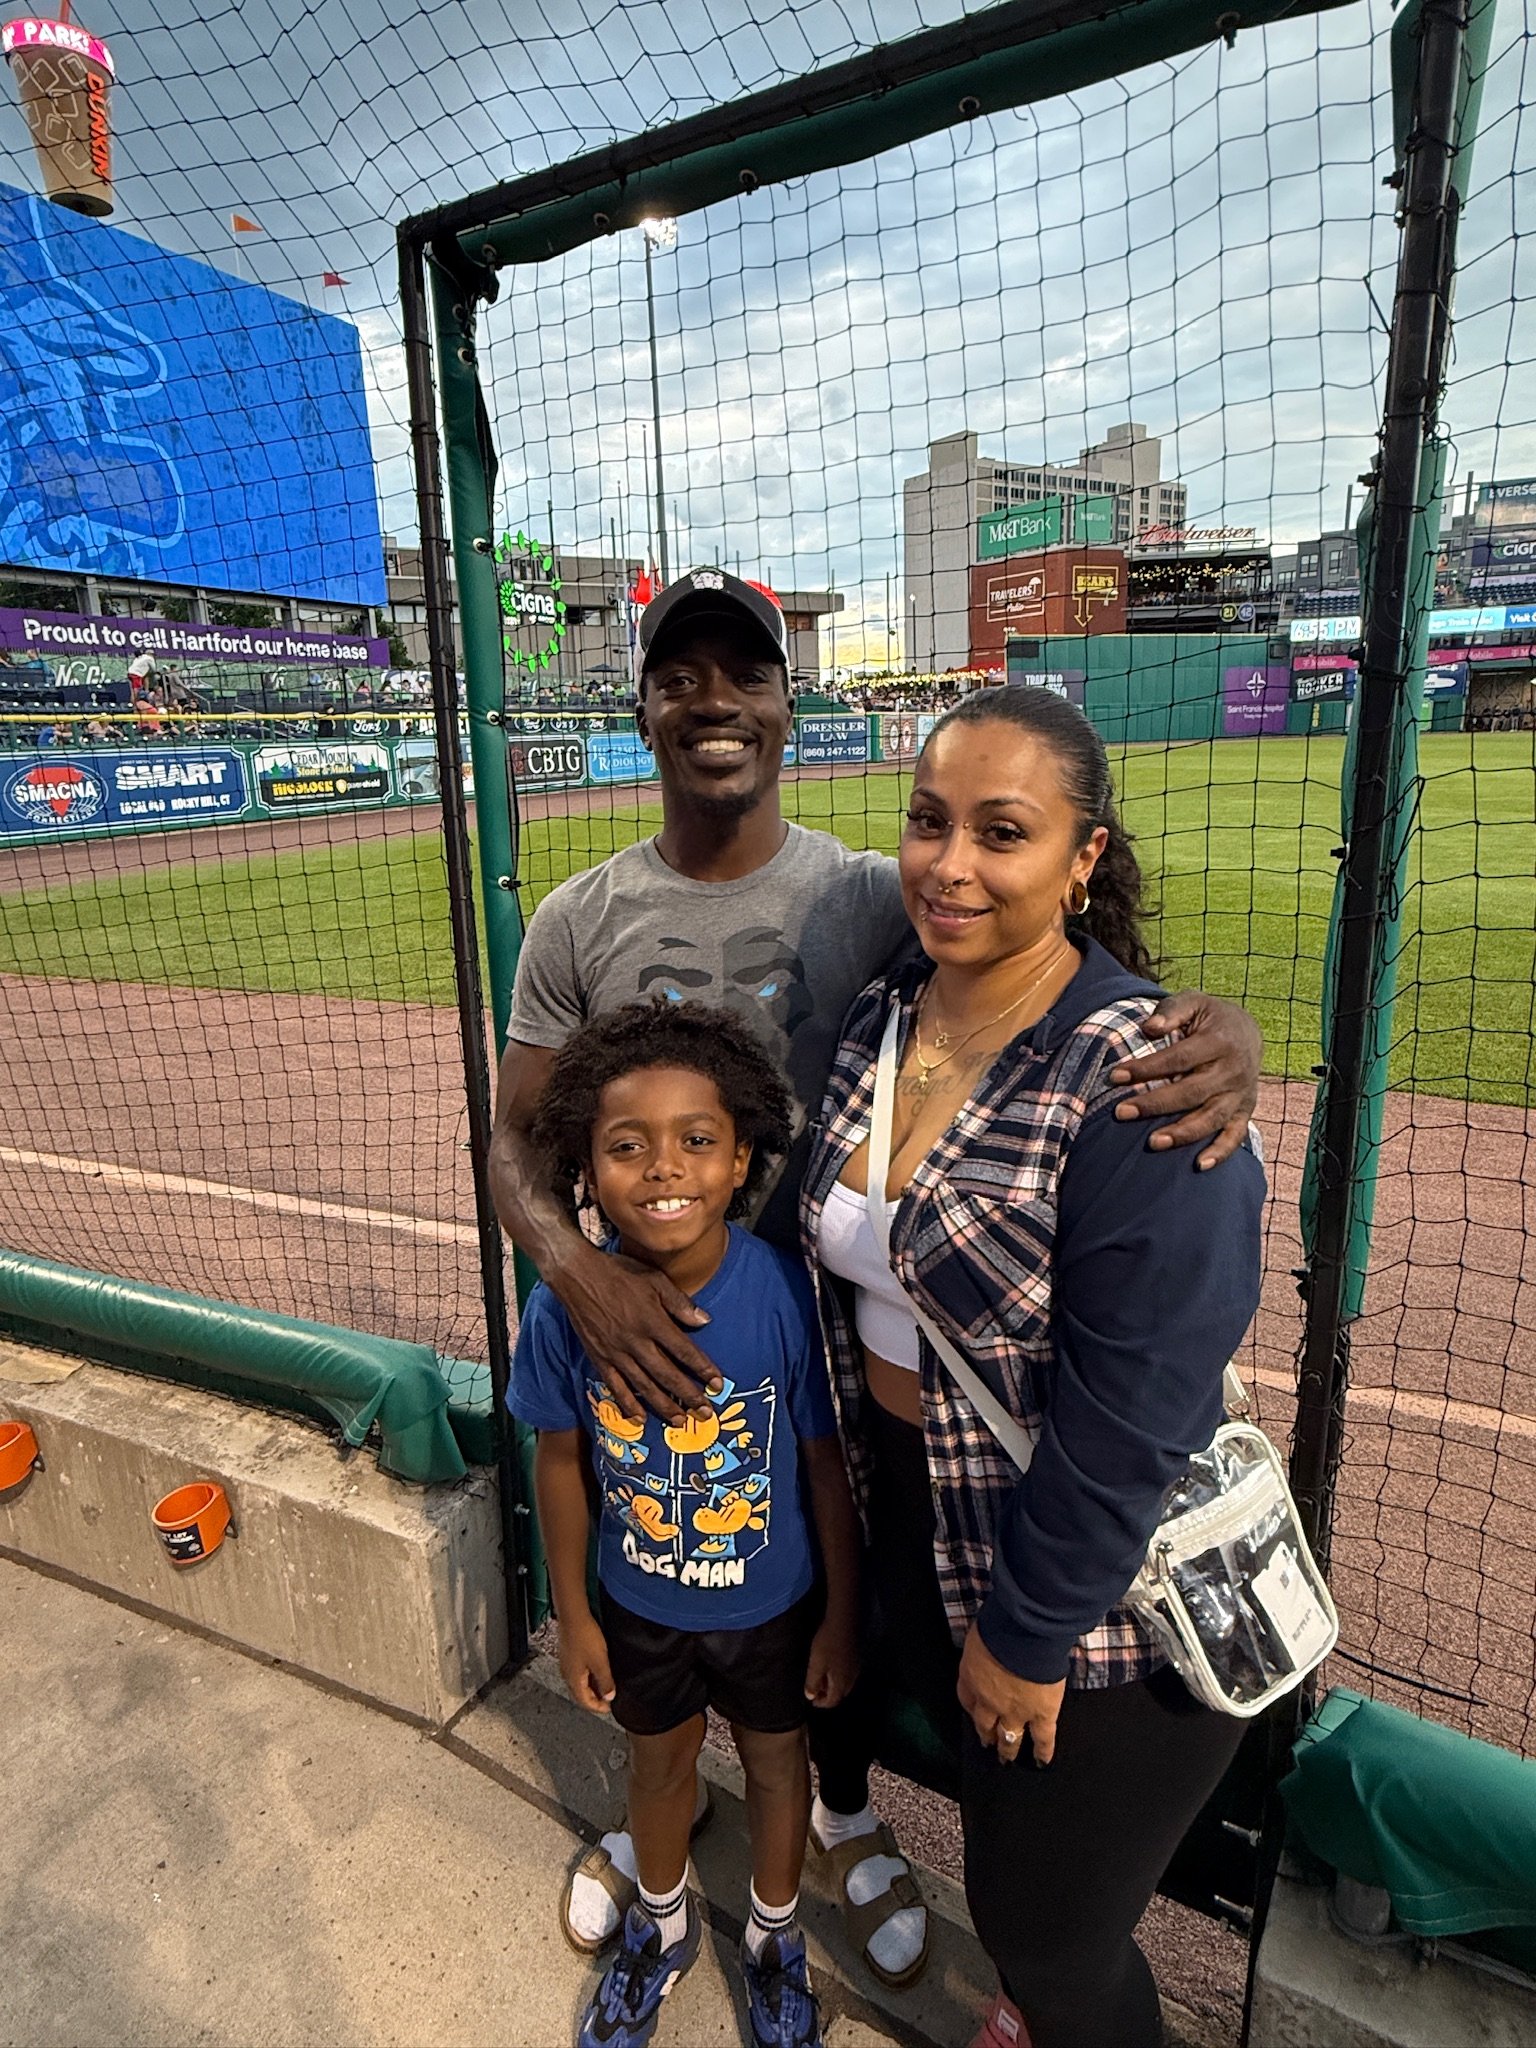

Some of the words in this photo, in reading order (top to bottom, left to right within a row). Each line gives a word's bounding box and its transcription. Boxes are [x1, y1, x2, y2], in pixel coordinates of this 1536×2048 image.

[23, 21, 90, 54] PARK!
[989, 519, 1021, 543] M&T
[1021, 516, 1052, 537] Bank
[1138, 524, 1256, 545] Budweiser
[1076, 576, 1114, 587] BEAR'S
[990, 585, 1033, 602] TRAVELERS
[23, 618, 99, 645] Proud
[101, 625, 126, 646] to
[129, 627, 169, 650] call
[170, 629, 250, 654] Hartford
[254, 638, 284, 656] our
[285, 637, 331, 658] home
[332, 640, 368, 660] base
[1294, 621, 1328, 639] 6:55
[1334, 619, 1359, 637] PM
[803, 721, 866, 734] DRESSLER
[820, 732, 849, 743] LAW
[291, 750, 318, 766] CEDAR
[528, 745, 580, 774] CBTG
[803, 747, 825, 758] (860)
[826, 746, 866, 757] 247-1122
[297, 766, 320, 778] Stone
[598, 756, 652, 771] RADIOLOGY
[115, 761, 227, 790] SMART
[15, 780, 98, 803] SMACNA
[119, 800, 148, 815] LOCAL
[171, 796, 200, 811] ROCKY
[200, 794, 221, 808] HILL,
[220, 793, 231, 806] CT
[622, 1530, 676, 1579] DOG
[680, 1558, 745, 1588] MAN
